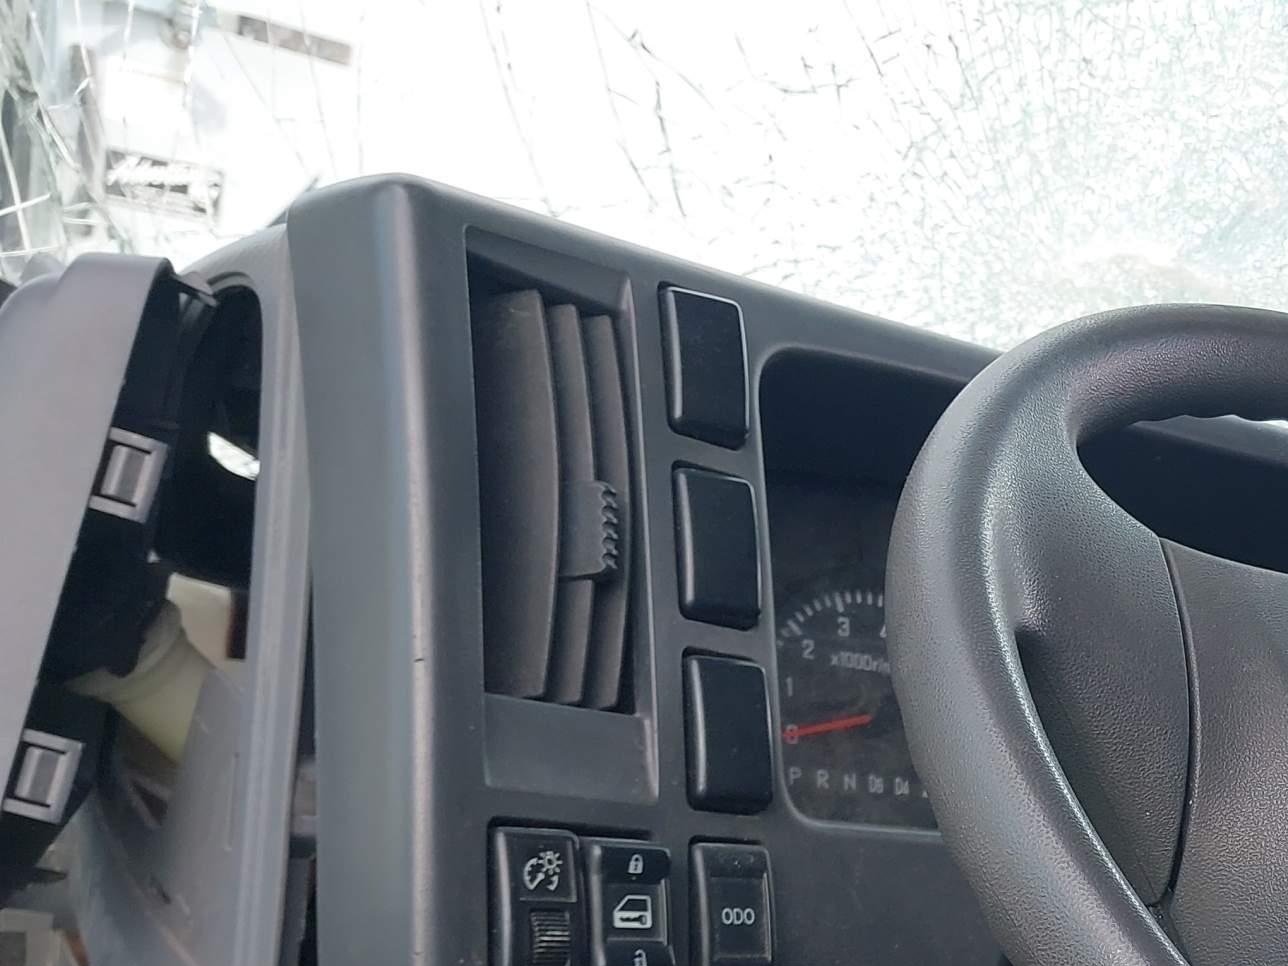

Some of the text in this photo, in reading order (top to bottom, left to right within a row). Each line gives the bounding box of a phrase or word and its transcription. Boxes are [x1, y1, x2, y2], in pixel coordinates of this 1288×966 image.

[837, 617, 850, 637] 3
[801, 639, 815, 659] 2
[786, 677, 793, 697] 1
[789, 767, 802, 786] P
[816, 769, 830, 789] R
[843, 773, 857, 791] N
[721, 907, 755, 925] ODO
